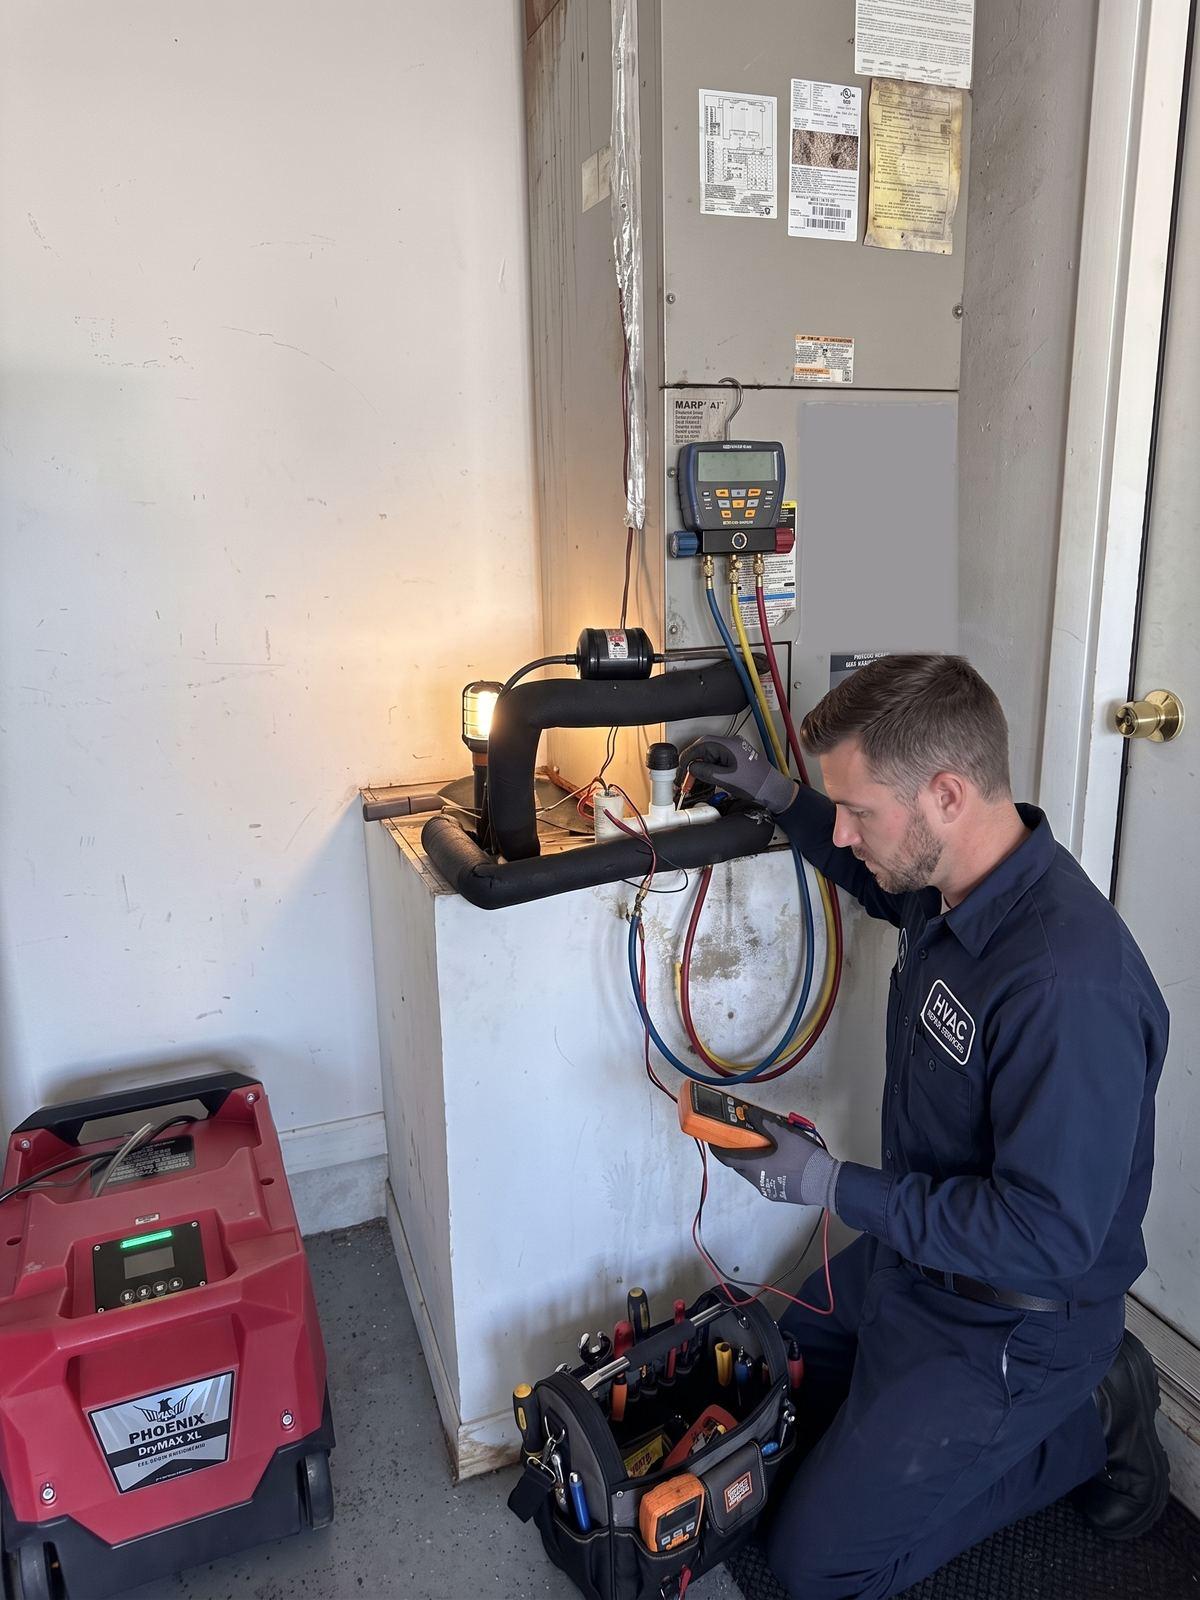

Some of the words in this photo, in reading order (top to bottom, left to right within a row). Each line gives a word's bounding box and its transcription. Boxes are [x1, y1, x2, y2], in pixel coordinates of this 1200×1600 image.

[933, 994, 967, 1040] HVAC
[128, 1412, 206, 1445] PHOENIX
[138, 1436, 184, 1456] DryMAX
[187, 1431, 202, 1442] XL
